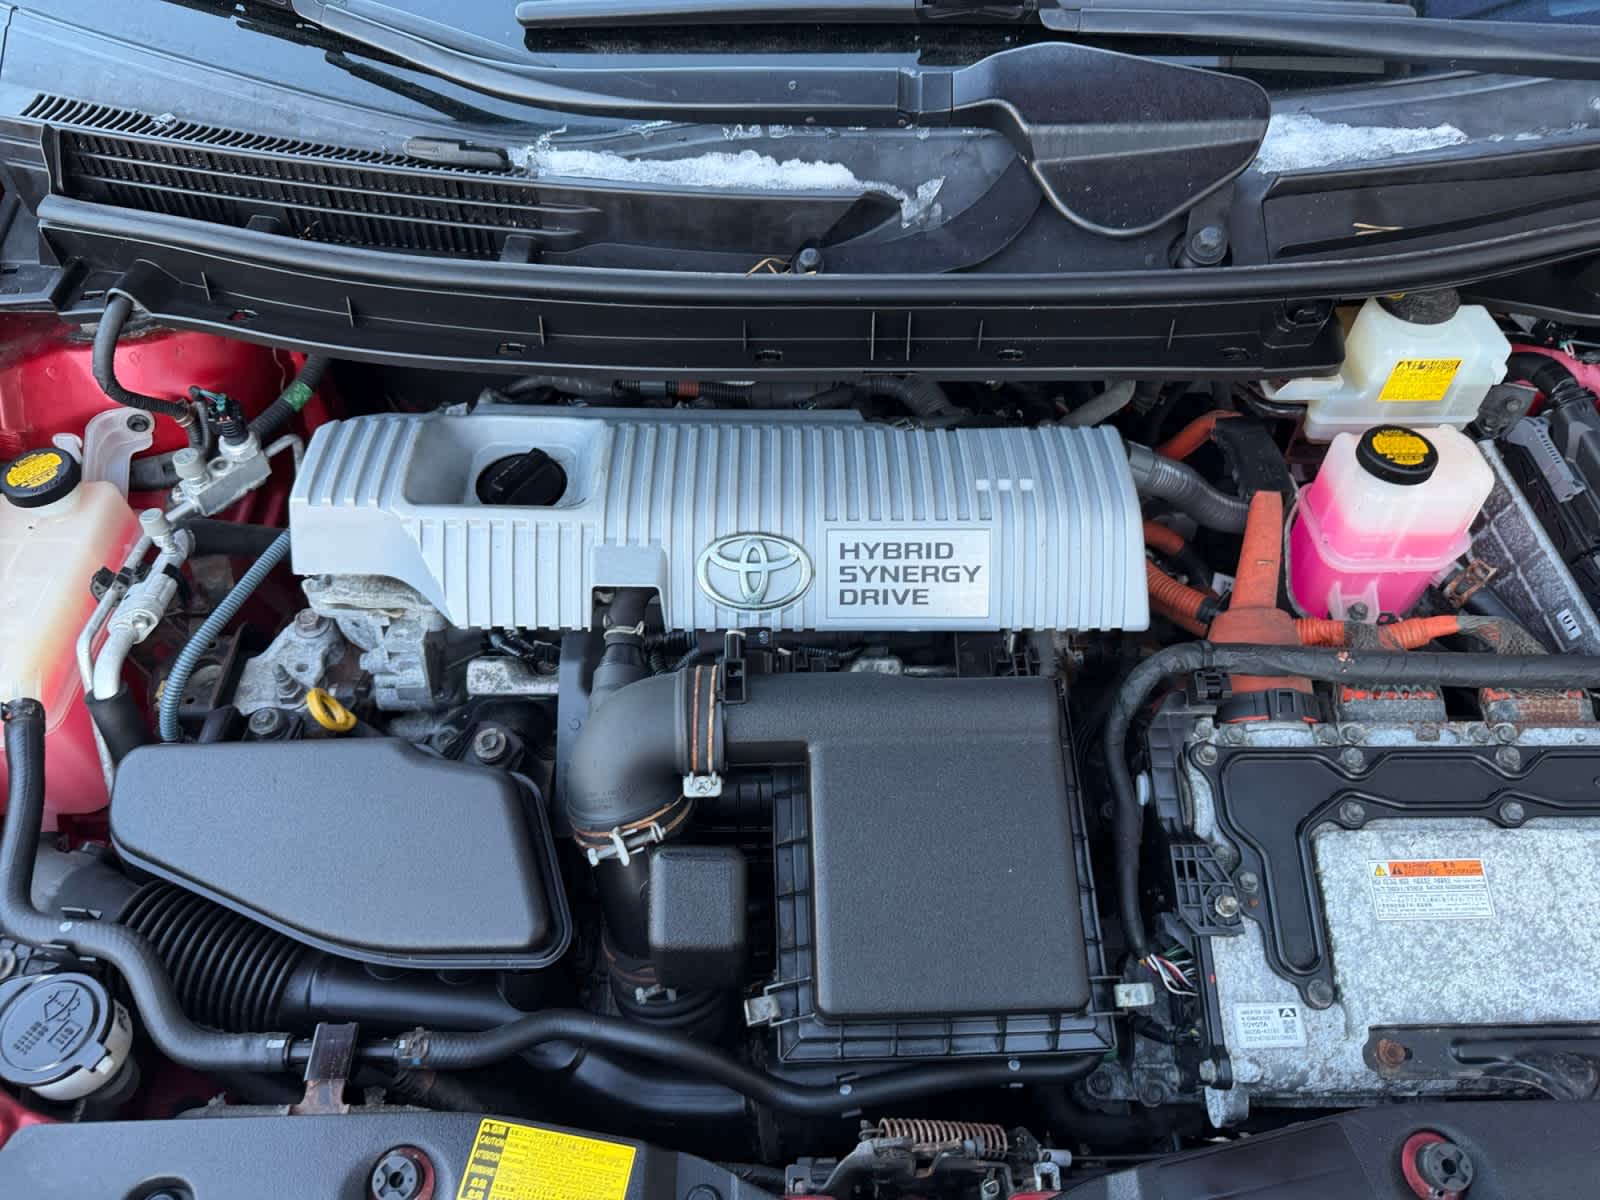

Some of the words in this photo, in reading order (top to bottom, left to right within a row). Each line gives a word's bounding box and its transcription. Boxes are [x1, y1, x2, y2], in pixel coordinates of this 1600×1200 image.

[840, 542, 954, 560] HYBRID
[839, 565, 982, 583] SYNERGY
[839, 588, 929, 606] DRIVE
[480, 1134, 506, 1147] CAUTION
